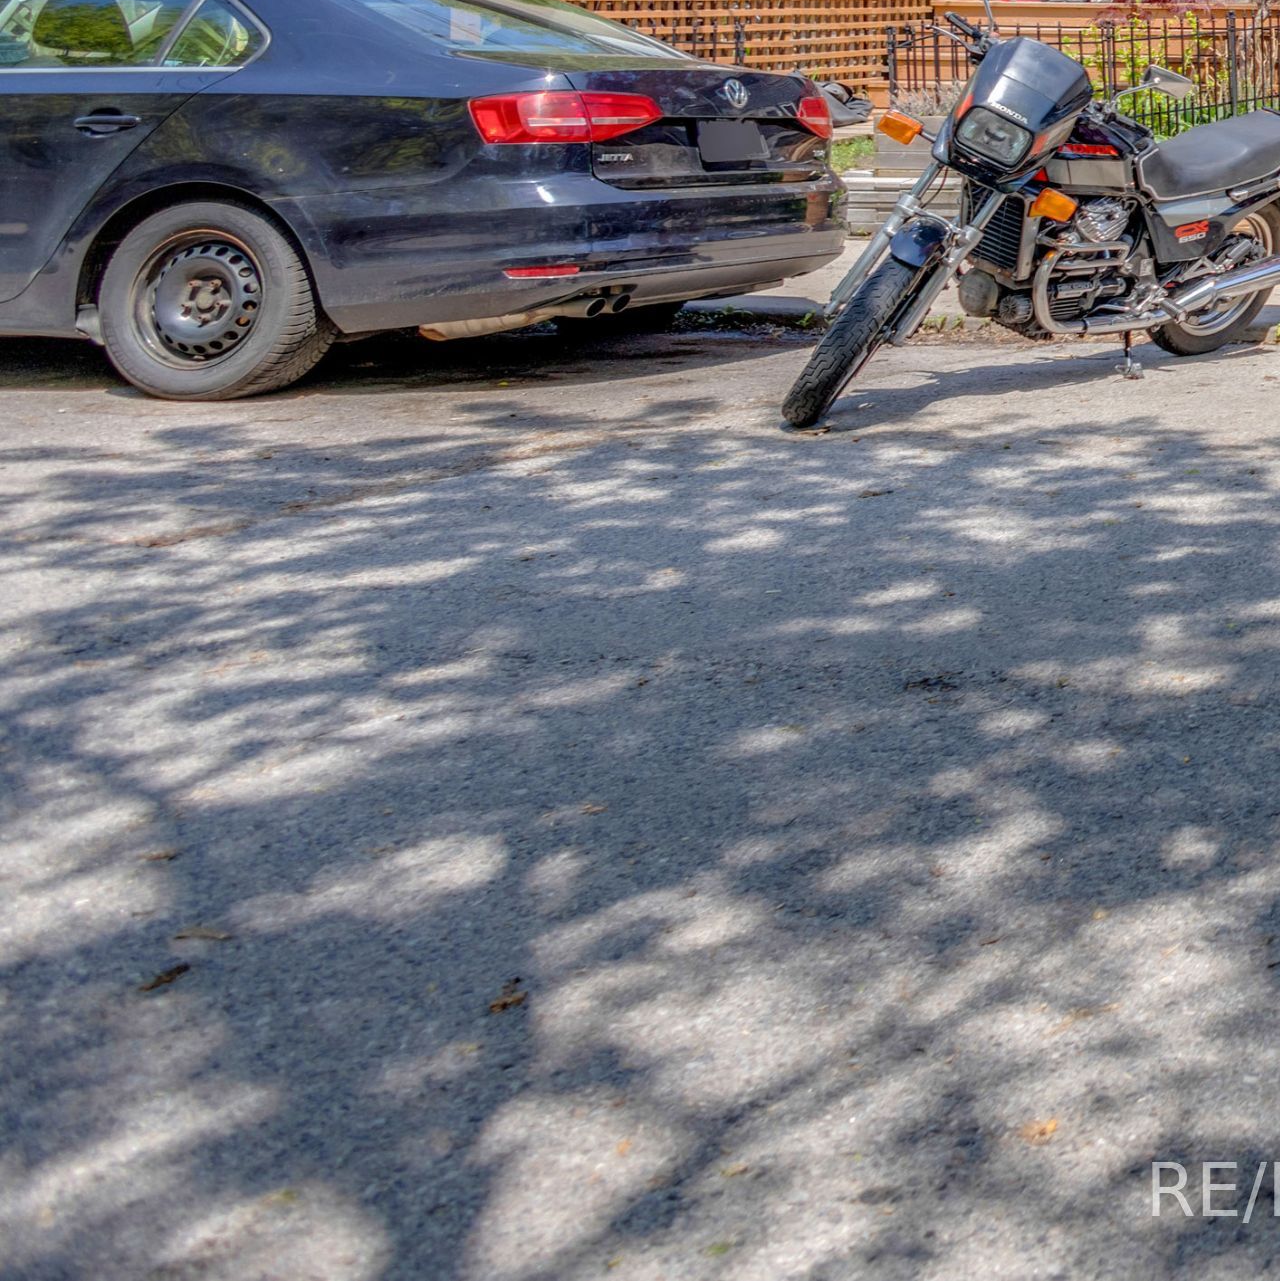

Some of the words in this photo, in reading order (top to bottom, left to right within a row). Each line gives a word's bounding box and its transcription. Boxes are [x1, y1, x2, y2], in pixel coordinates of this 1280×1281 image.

[989, 100, 1029, 125] HONDA
[597, 153, 634, 162] JETTA
[1175, 220, 1209, 238] CX
